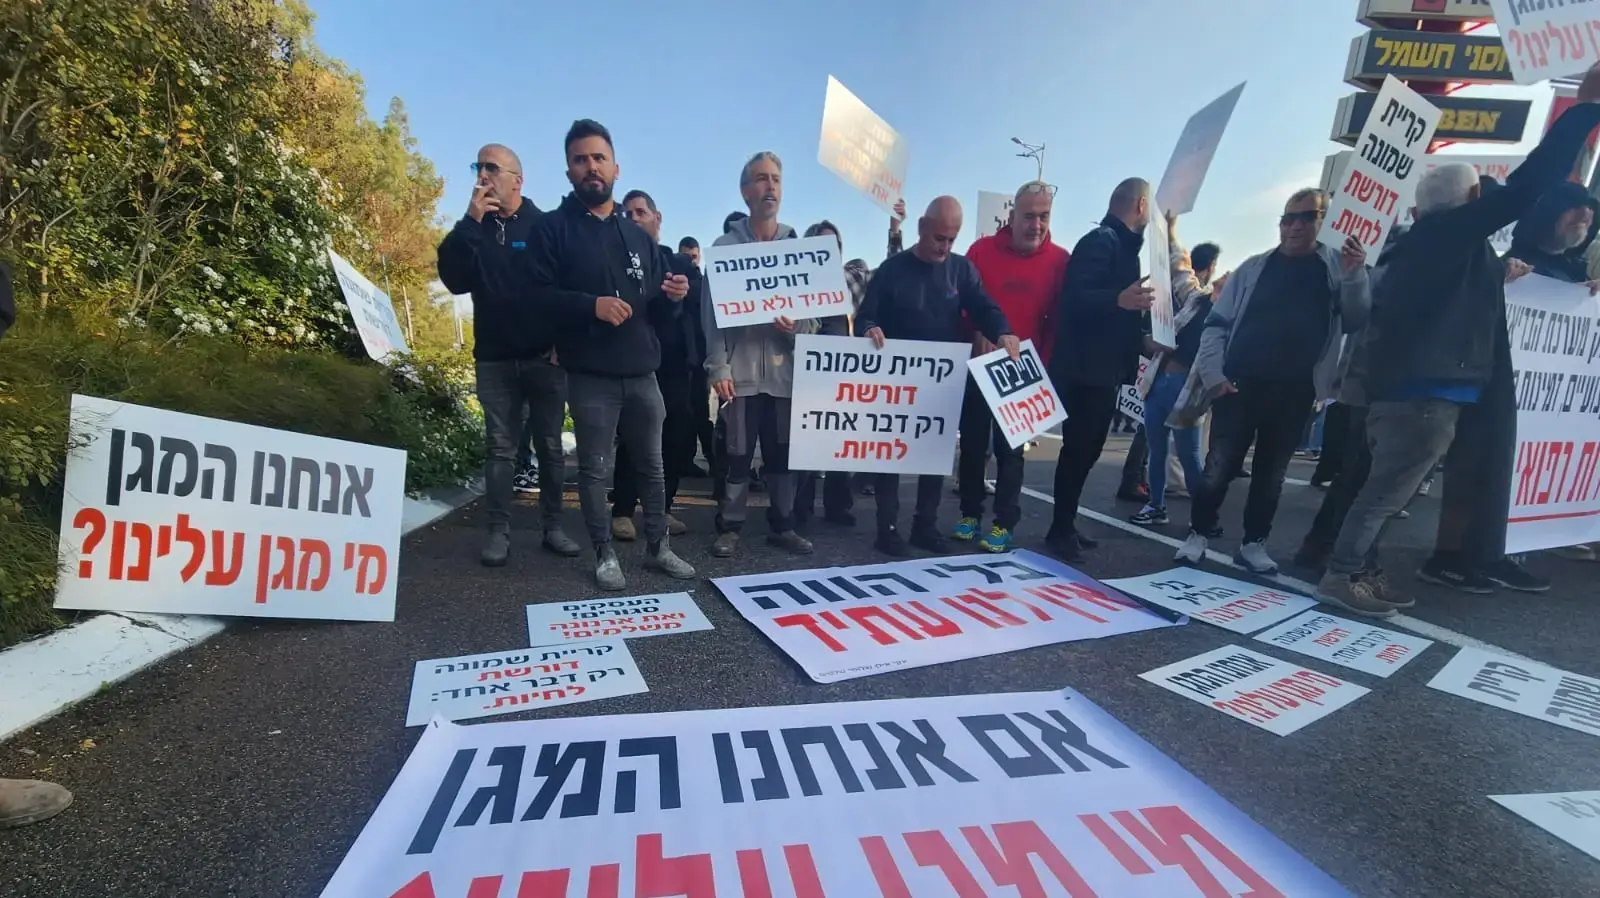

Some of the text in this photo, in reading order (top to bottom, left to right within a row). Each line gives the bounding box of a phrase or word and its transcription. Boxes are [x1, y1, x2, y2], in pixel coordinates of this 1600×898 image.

[1374, 36, 1506, 72] סני חשמל
[1380, 98, 1427, 148] קריית
[1437, 108, 1501, 133] BEN
[1360, 133, 1415, 180] שמונה
[1344, 169, 1399, 216] דורשת
[1331, 208, 1382, 247] לחיות.
[714, 248, 831, 274] קרית שמונה
[745, 272, 810, 292] דורשת
[717, 290, 845, 316] עתיד ולא עבר
[805, 350, 955, 383] קריית שמונה
[835, 382, 917, 405] דורשת
[801, 409, 945, 439] רק דבר אחד:
[998, 385, 1056, 436] לבנק!!!
[834, 438, 908, 460] לחיות.
[106, 428, 374, 517] אנחנו המגן
[1515, 442, 1574, 505] רפואי
[73, 507, 388, 604] מי מגן עלינו?
[740, 560, 1058, 610] בלי הווה
[562, 597, 661, 612] העסקים
[571, 605, 660, 619] סגורים!
[773, 582, 1143, 652] אין לנו עתיד
[549, 612, 687, 631] ואת ארנונה
[563, 621, 683, 639] משלמים!
[434, 644, 614, 675] קריית שמונה
[477, 660, 581, 682] דורשת
[1205, 653, 1275, 682] אנחנו
[431, 667, 626, 703] רק דבר אחד:
[1292, 671, 1342, 688] מי
[482, 685, 587, 710] לחיות.
[405, 709, 1131, 855] אם אנחנו המגן
